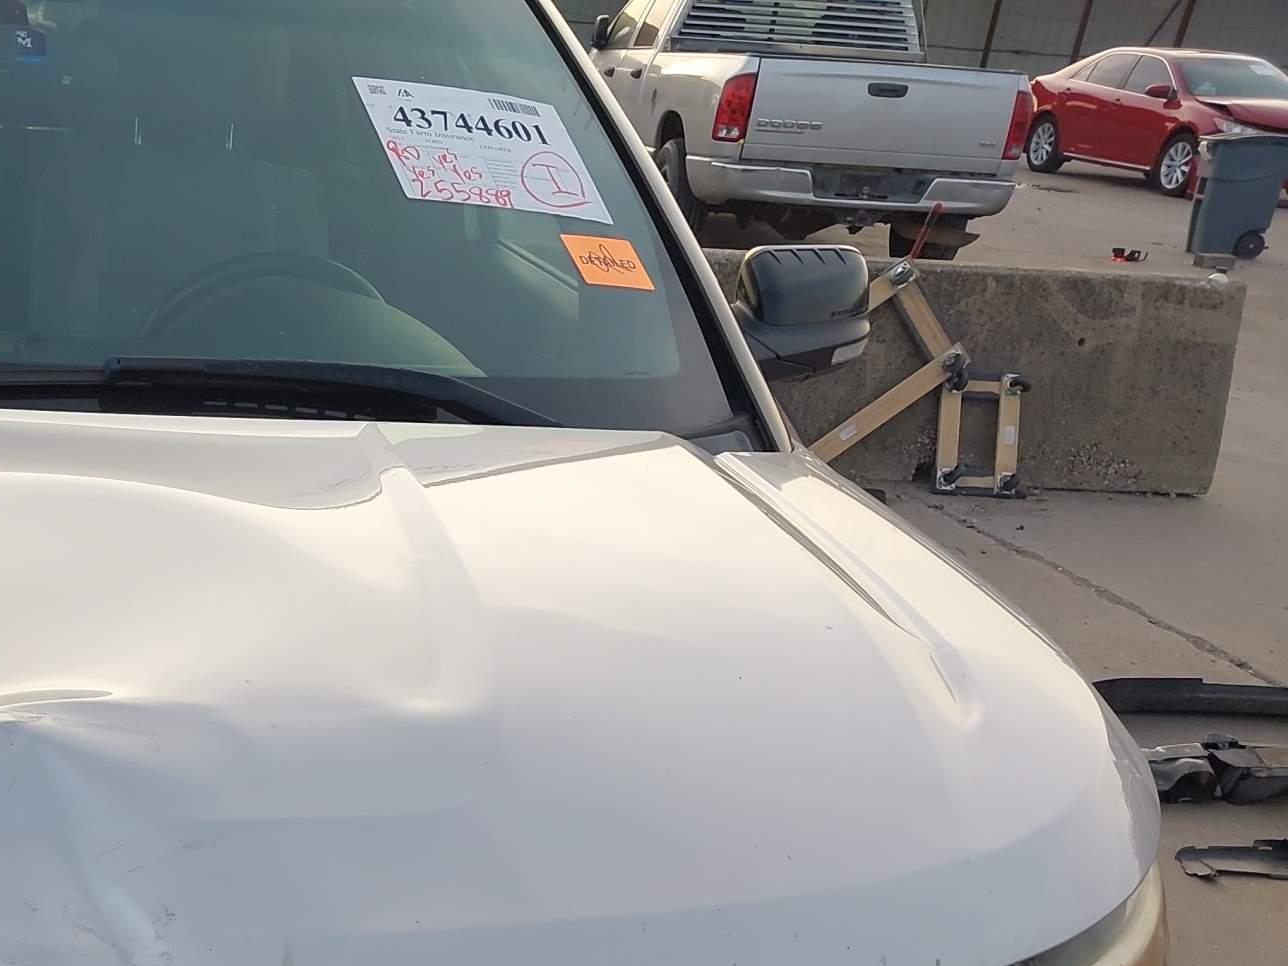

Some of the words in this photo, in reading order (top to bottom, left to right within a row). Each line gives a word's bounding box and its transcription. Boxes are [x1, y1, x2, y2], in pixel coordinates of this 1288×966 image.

[393, 106, 551, 146] 43744601
[756, 117, 824, 130] DODGE
[385, 126, 408, 135] State
[409, 128, 433, 138] Farm
[434, 131, 474, 142] Insurance
